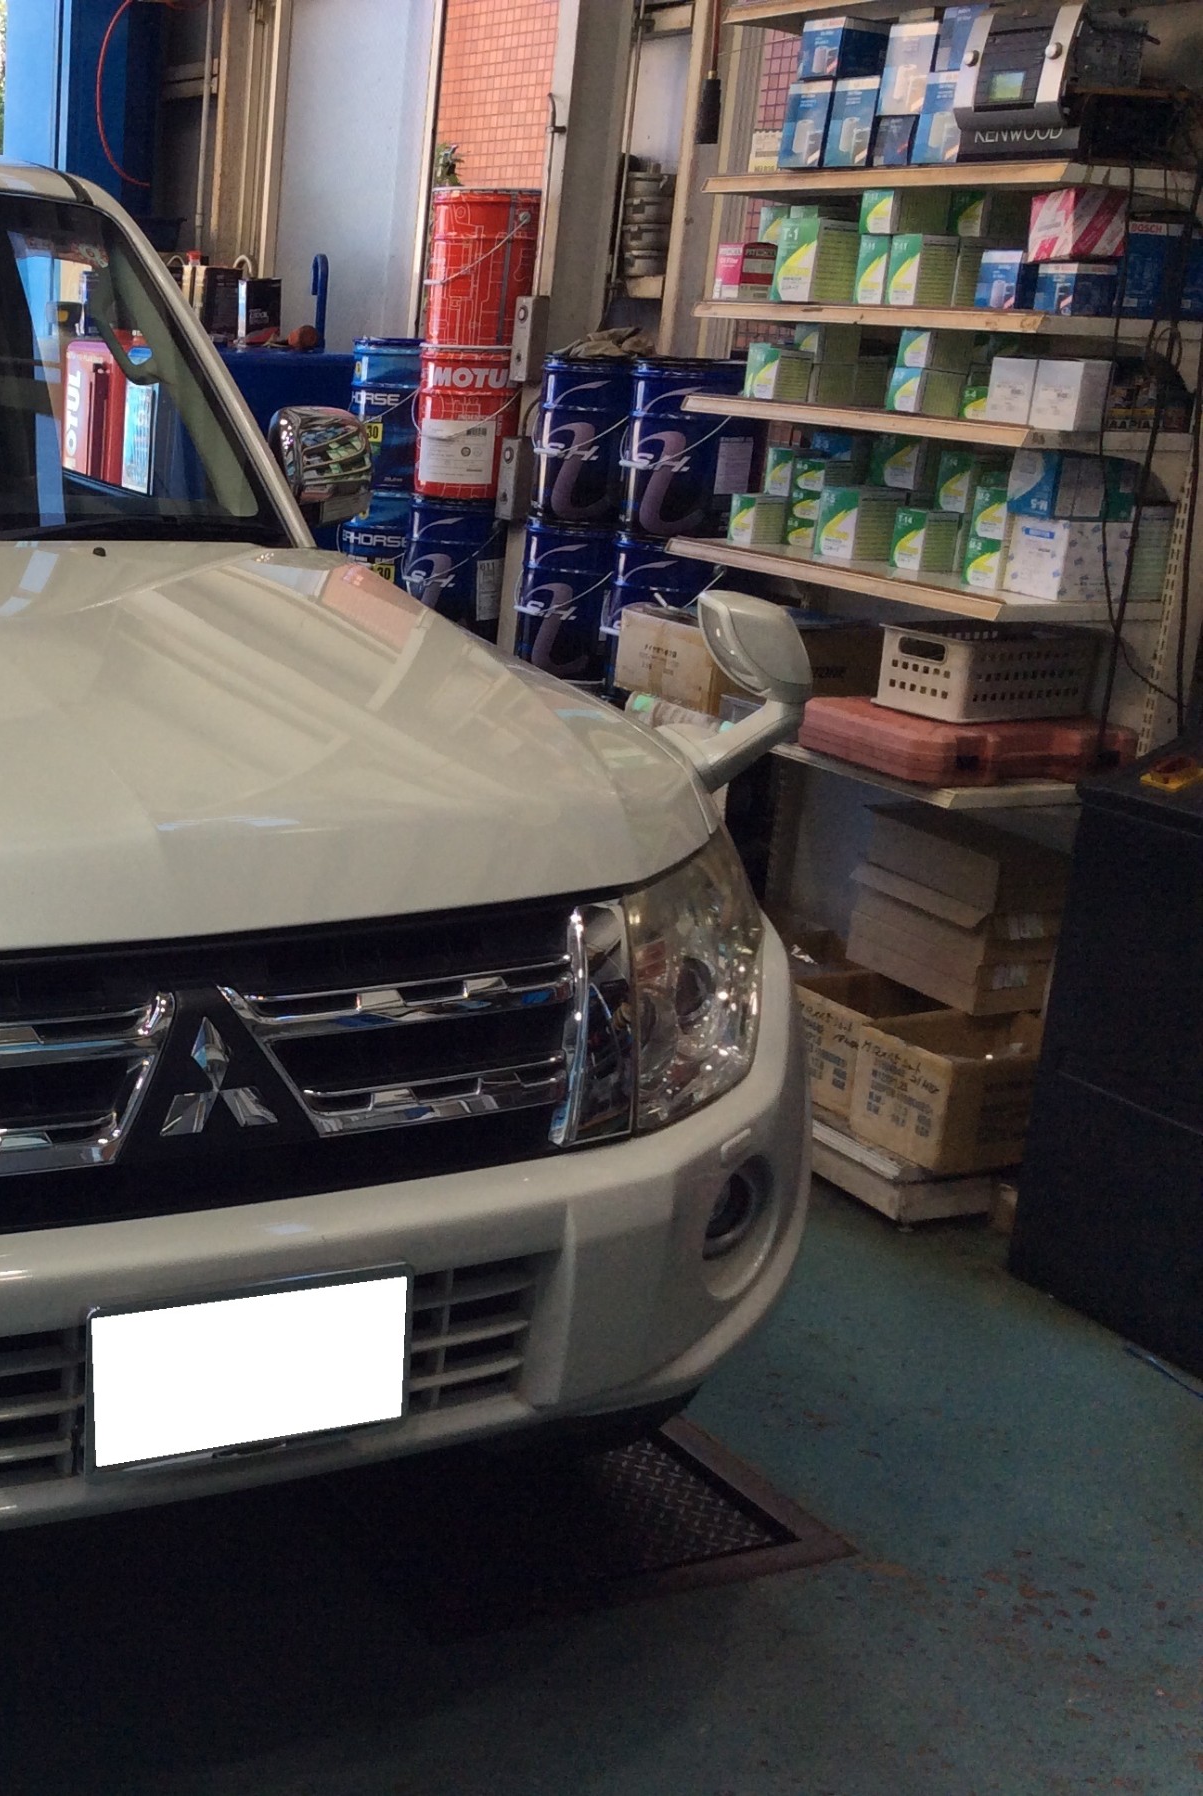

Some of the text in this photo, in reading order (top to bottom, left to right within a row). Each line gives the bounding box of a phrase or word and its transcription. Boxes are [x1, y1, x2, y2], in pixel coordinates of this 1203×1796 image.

[1131, 223, 1162, 233] BOSCH
[782, 228, 798, 241] T-1
[898, 514, 913, 525] T-14
